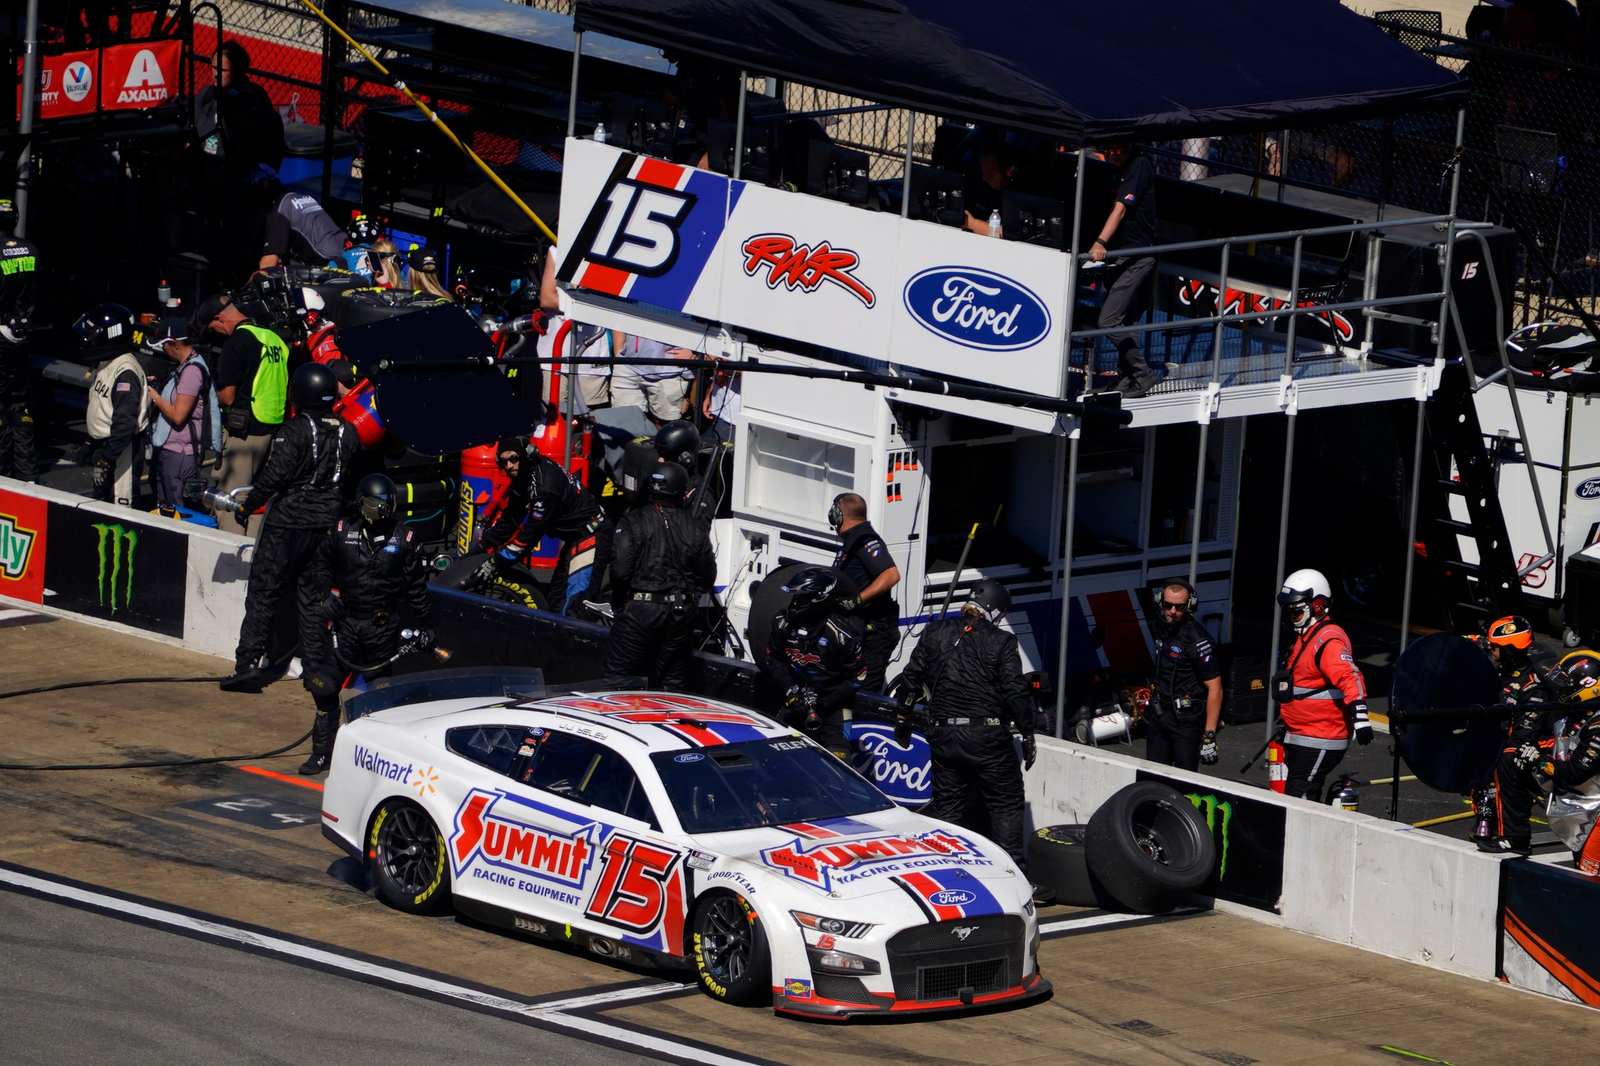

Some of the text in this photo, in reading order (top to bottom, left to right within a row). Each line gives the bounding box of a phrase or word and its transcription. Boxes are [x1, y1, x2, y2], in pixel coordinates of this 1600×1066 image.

[66, 82, 88, 94] VALVOLINE
[117, 87, 168, 103] AXALTA
[589, 182, 690, 269] 15
[743, 233, 876, 308] RWR
[1461, 261, 1479, 280] 15
[932, 276, 1023, 338] Ford
[576, 727, 609, 741] YELEY
[768, 740, 807, 751] YELEY
[354, 744, 413, 785] Walmart
[852, 732, 932, 792] Ford
[586, 834, 678, 929] 15
[707, 871, 757, 895] GOODYEAR
[836, 858, 995, 885] RACING EQUIPMENT
[472, 868, 581, 906] RACING EQUIPMENT
[815, 934, 838, 950] 15
[694, 932, 727, 997] GOODYEAR
[786, 983, 810, 993] SUNOCO
